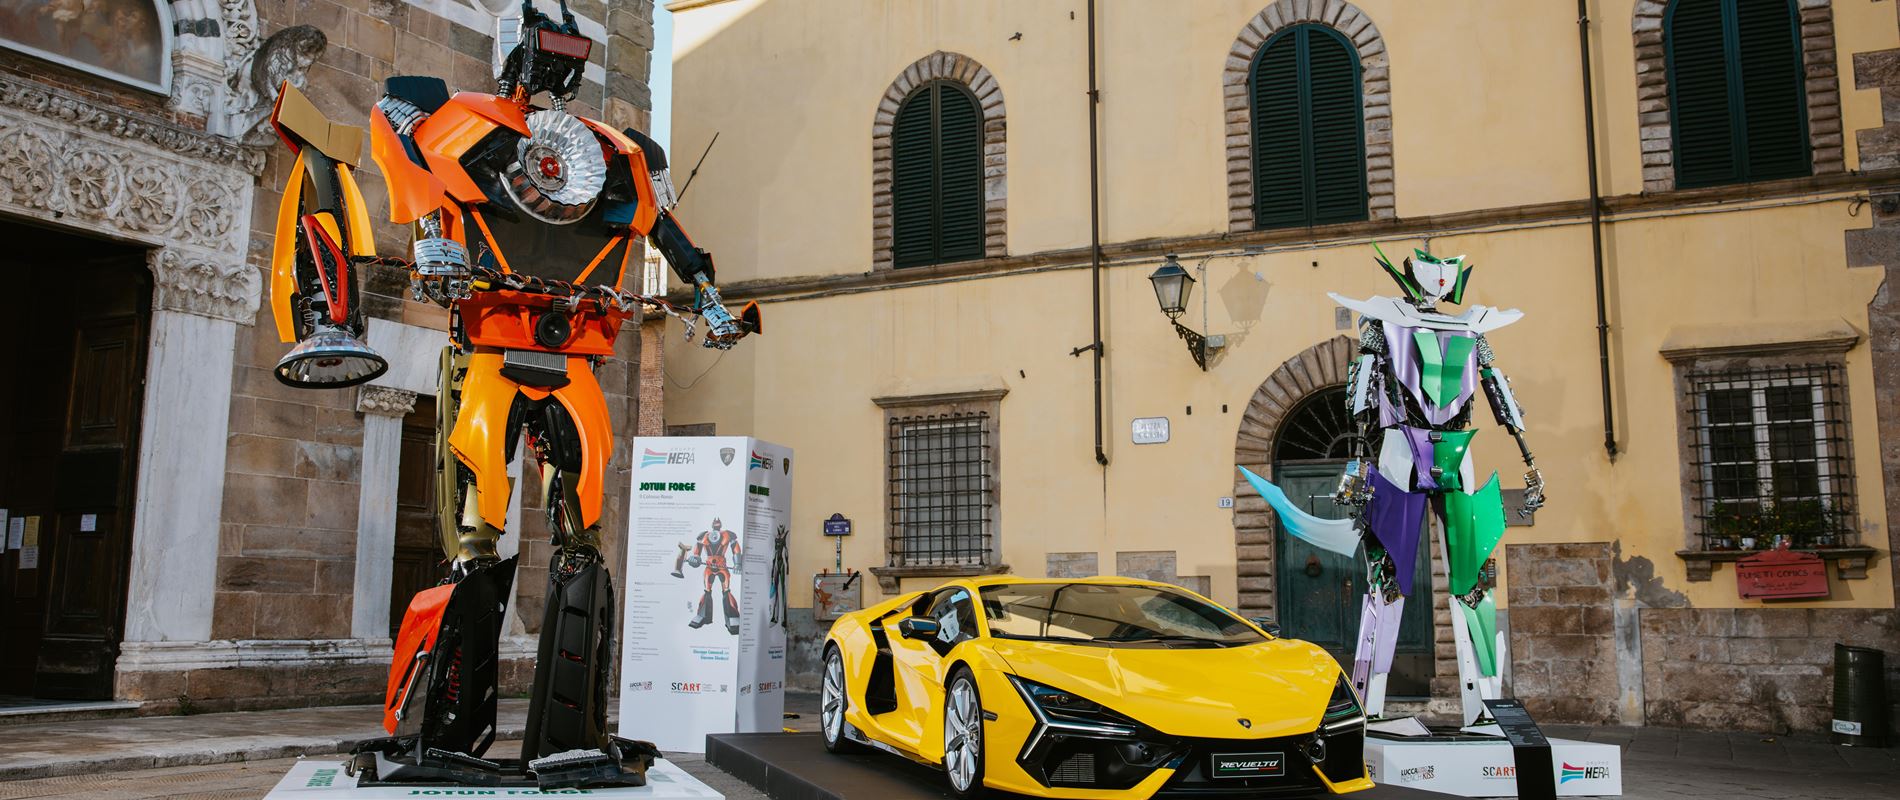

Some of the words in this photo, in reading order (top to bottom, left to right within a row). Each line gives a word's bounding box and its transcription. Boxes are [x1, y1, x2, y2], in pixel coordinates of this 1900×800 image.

[667, 452, 695, 464] HERA
[639, 482, 666, 491] JOTUN
[668, 482, 696, 491] FORGE
[1776, 569, 1809, 578] COMICS
[671, 682, 701, 692] SCART
[1220, 760, 1279, 768] REVUELTO
[1482, 766, 1516, 776] SCART
[1585, 767, 1610, 779] HERA
